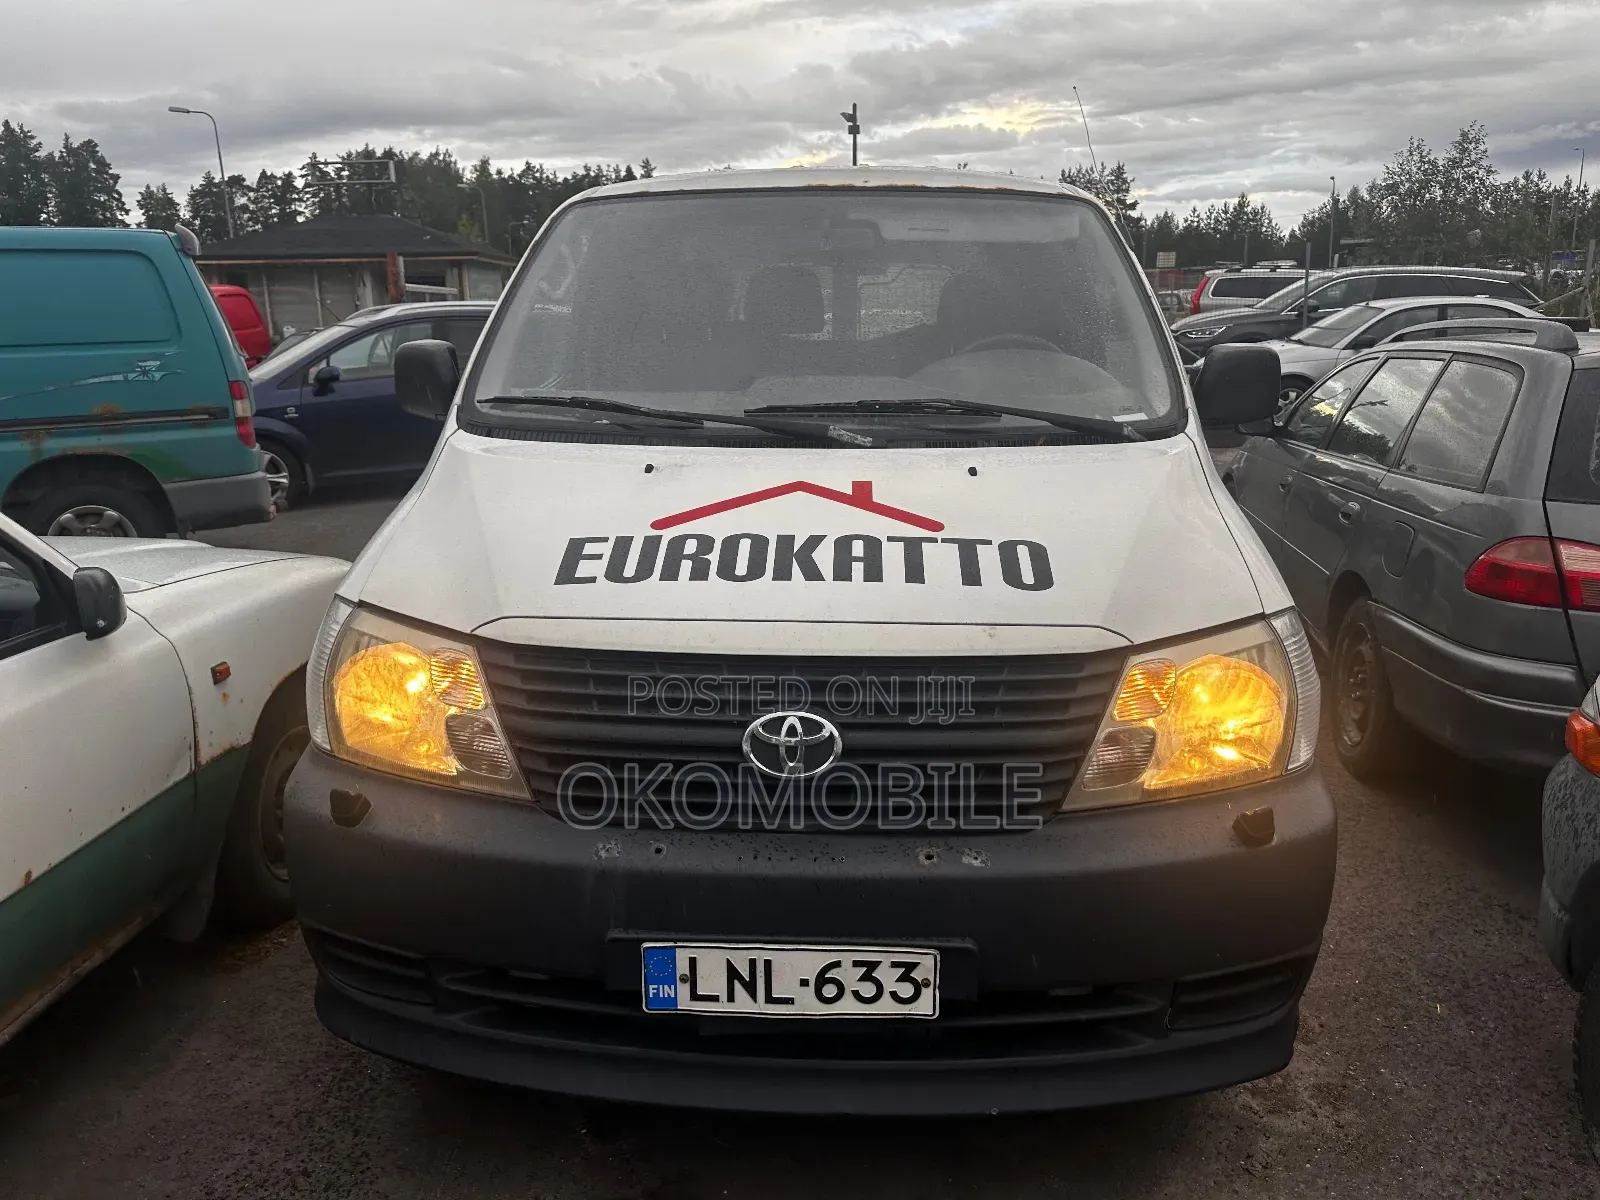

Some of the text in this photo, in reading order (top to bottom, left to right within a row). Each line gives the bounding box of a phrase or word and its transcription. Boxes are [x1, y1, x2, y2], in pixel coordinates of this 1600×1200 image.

[554, 532, 1055, 592] EUROKATTO
[648, 984, 675, 999] FIN
[688, 955, 923, 1006] LNL-633
